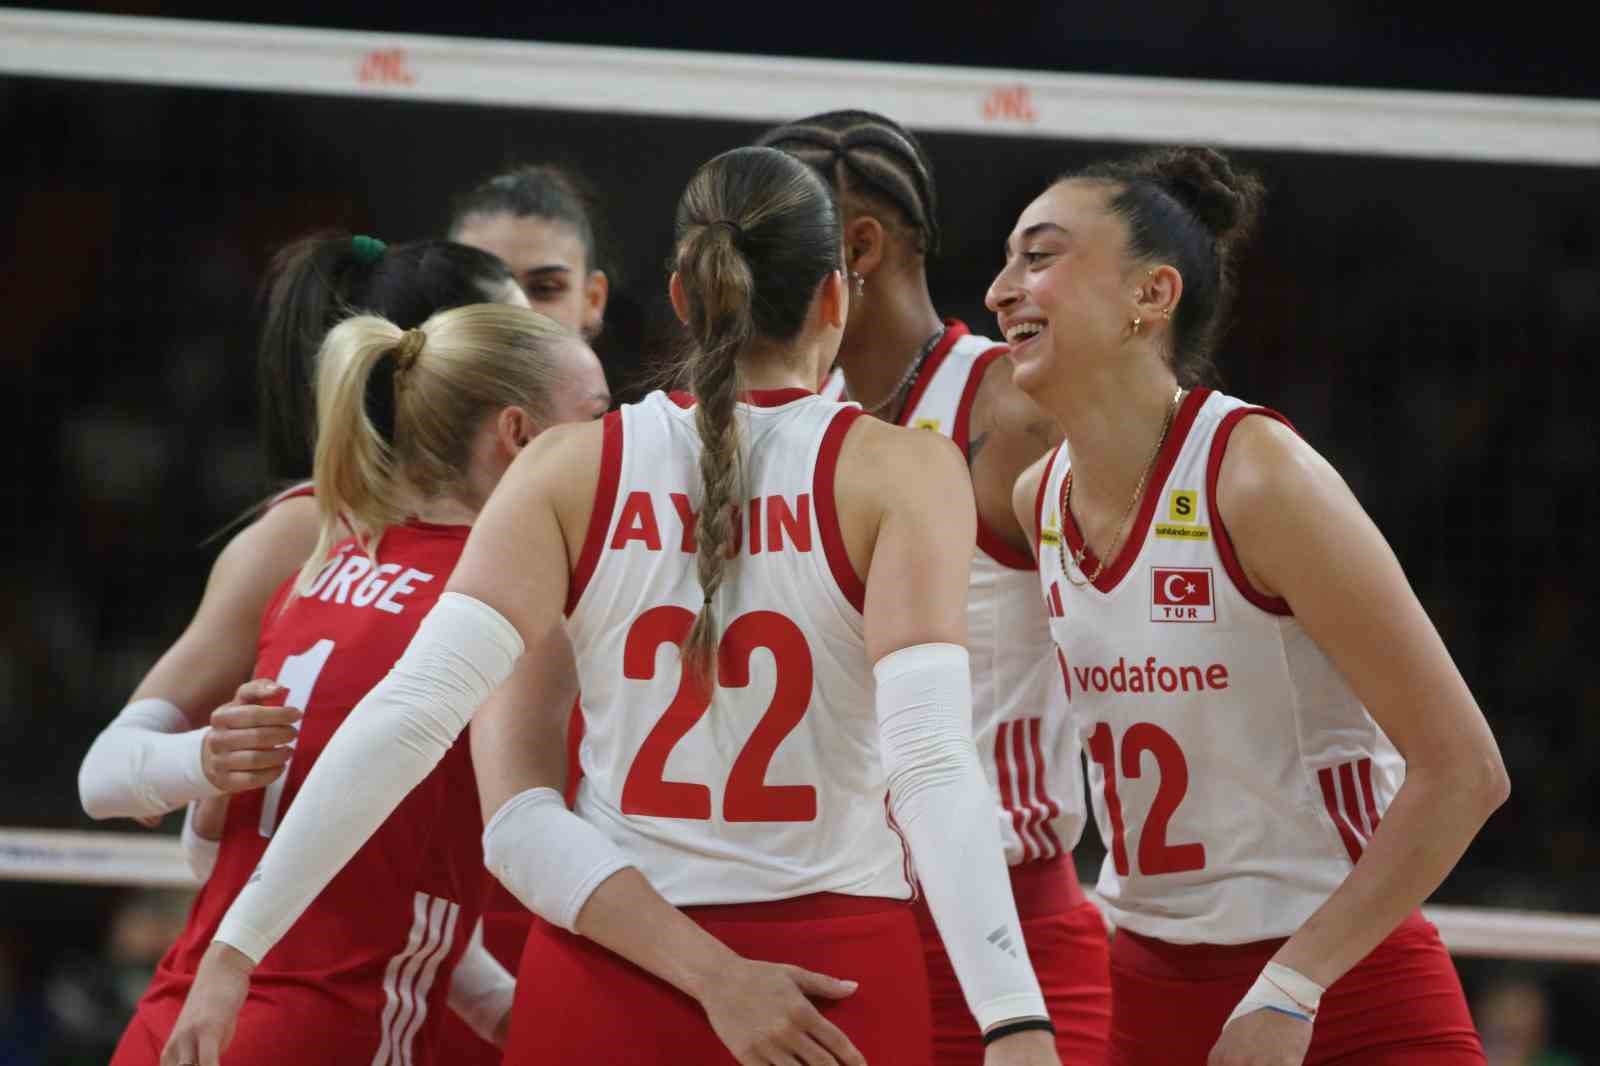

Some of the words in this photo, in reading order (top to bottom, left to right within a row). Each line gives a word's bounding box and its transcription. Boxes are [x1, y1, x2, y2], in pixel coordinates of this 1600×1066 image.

[1176, 496, 1190, 515] S
[1163, 607, 1197, 618] TUR
[620, 604, 817, 823] 22
[1073, 656, 1229, 693] vodafone
[259, 638, 336, 838] 1
[1087, 721, 1206, 877] 12
